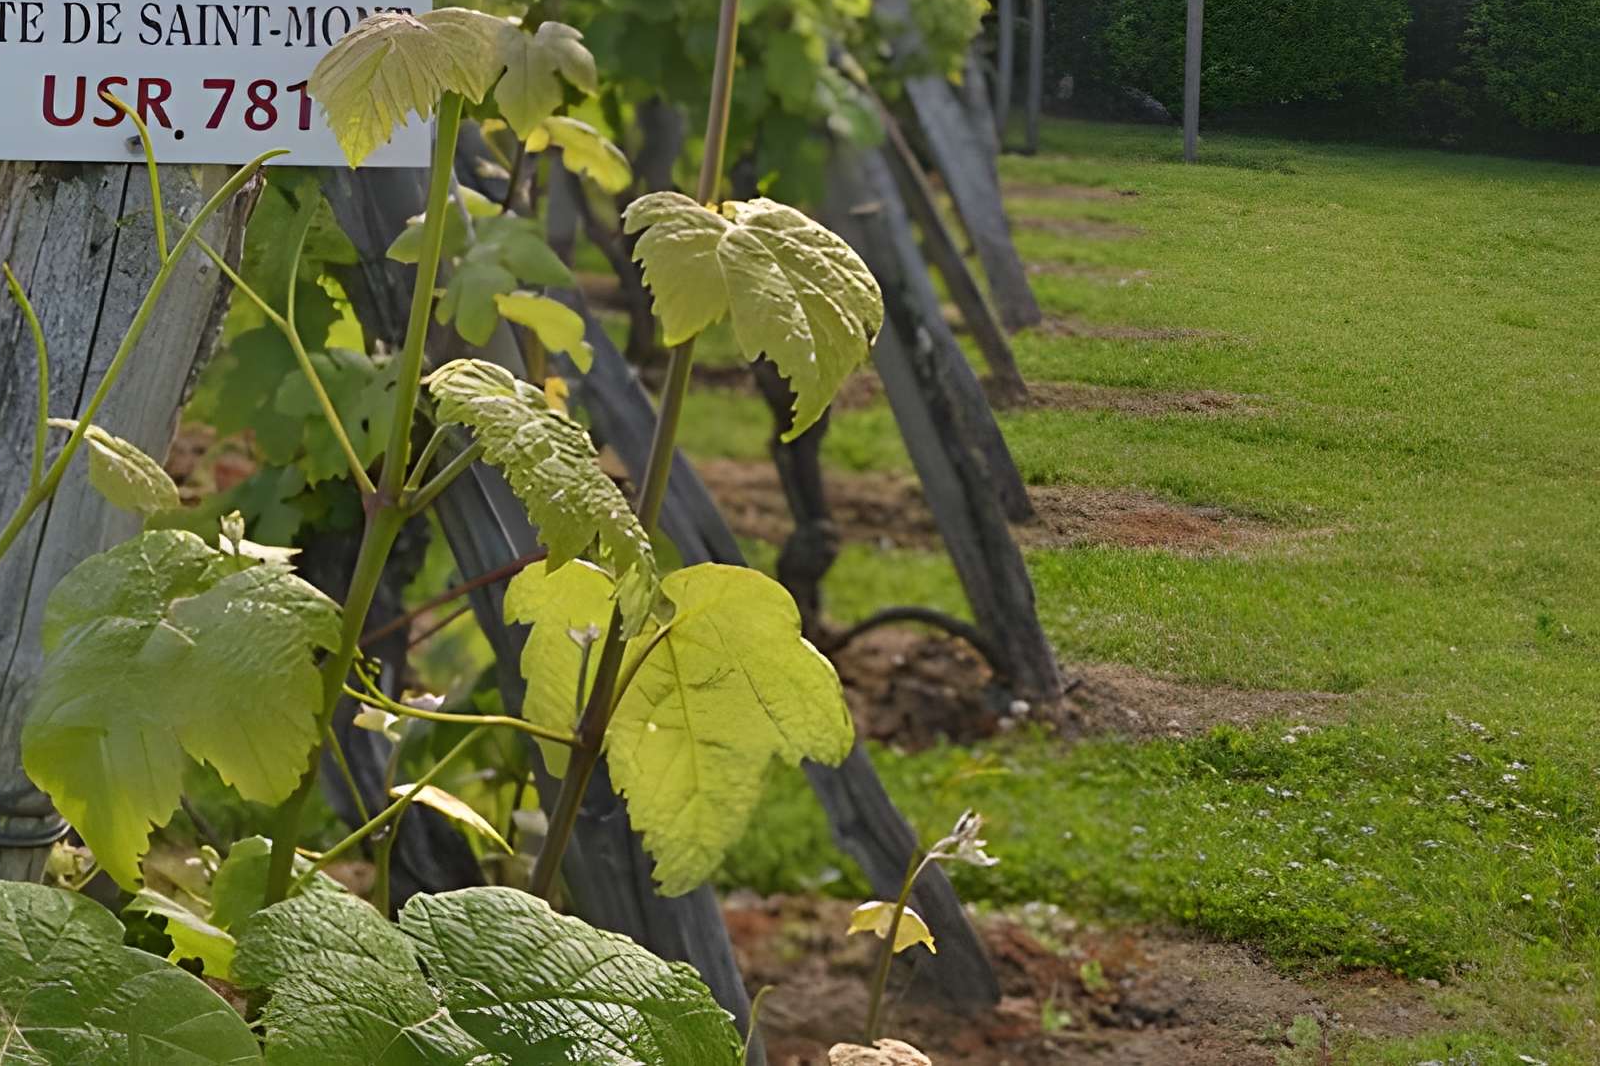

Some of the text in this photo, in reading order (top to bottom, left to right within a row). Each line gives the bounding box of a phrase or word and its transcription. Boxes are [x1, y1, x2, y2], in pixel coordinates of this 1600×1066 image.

[62, 1, 122, 45] DE
[138, 2, 412, 48] SAINT-MO
[202, 78, 312, 132] 781
